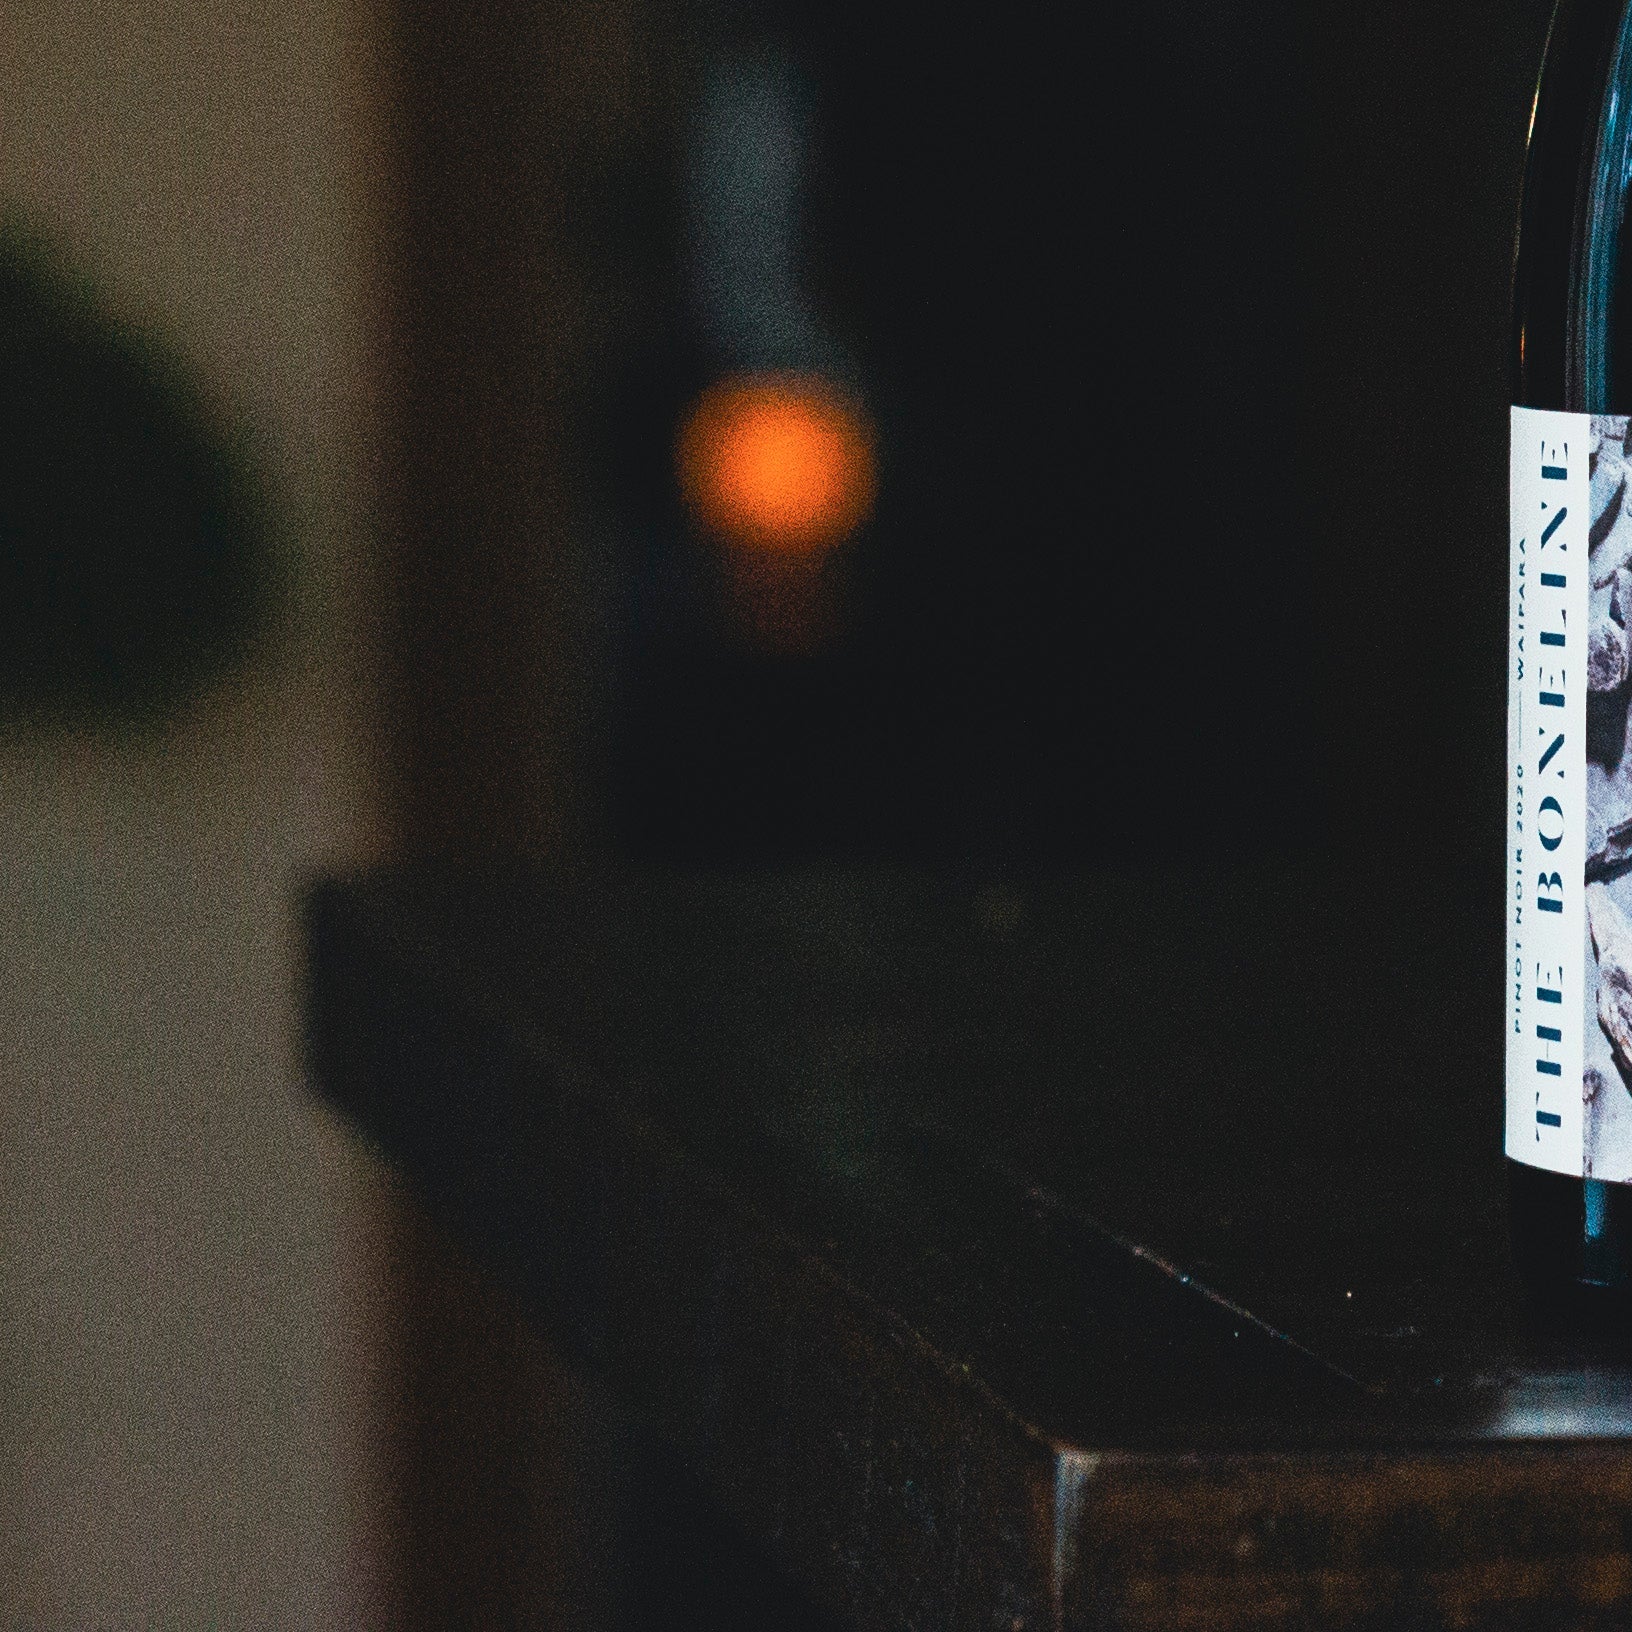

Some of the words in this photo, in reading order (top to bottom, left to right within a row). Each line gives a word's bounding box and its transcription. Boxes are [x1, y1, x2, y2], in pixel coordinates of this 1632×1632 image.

[1516, 538, 1525, 681] WAIPARA
[1536, 441, 1567, 914] BONELINE
[1515, 764, 1523, 833] 2020
[1515, 848, 1523, 924] NOIR
[1514, 939, 1522, 1034] PINOT
[1535, 962, 1562, 1142] THE
